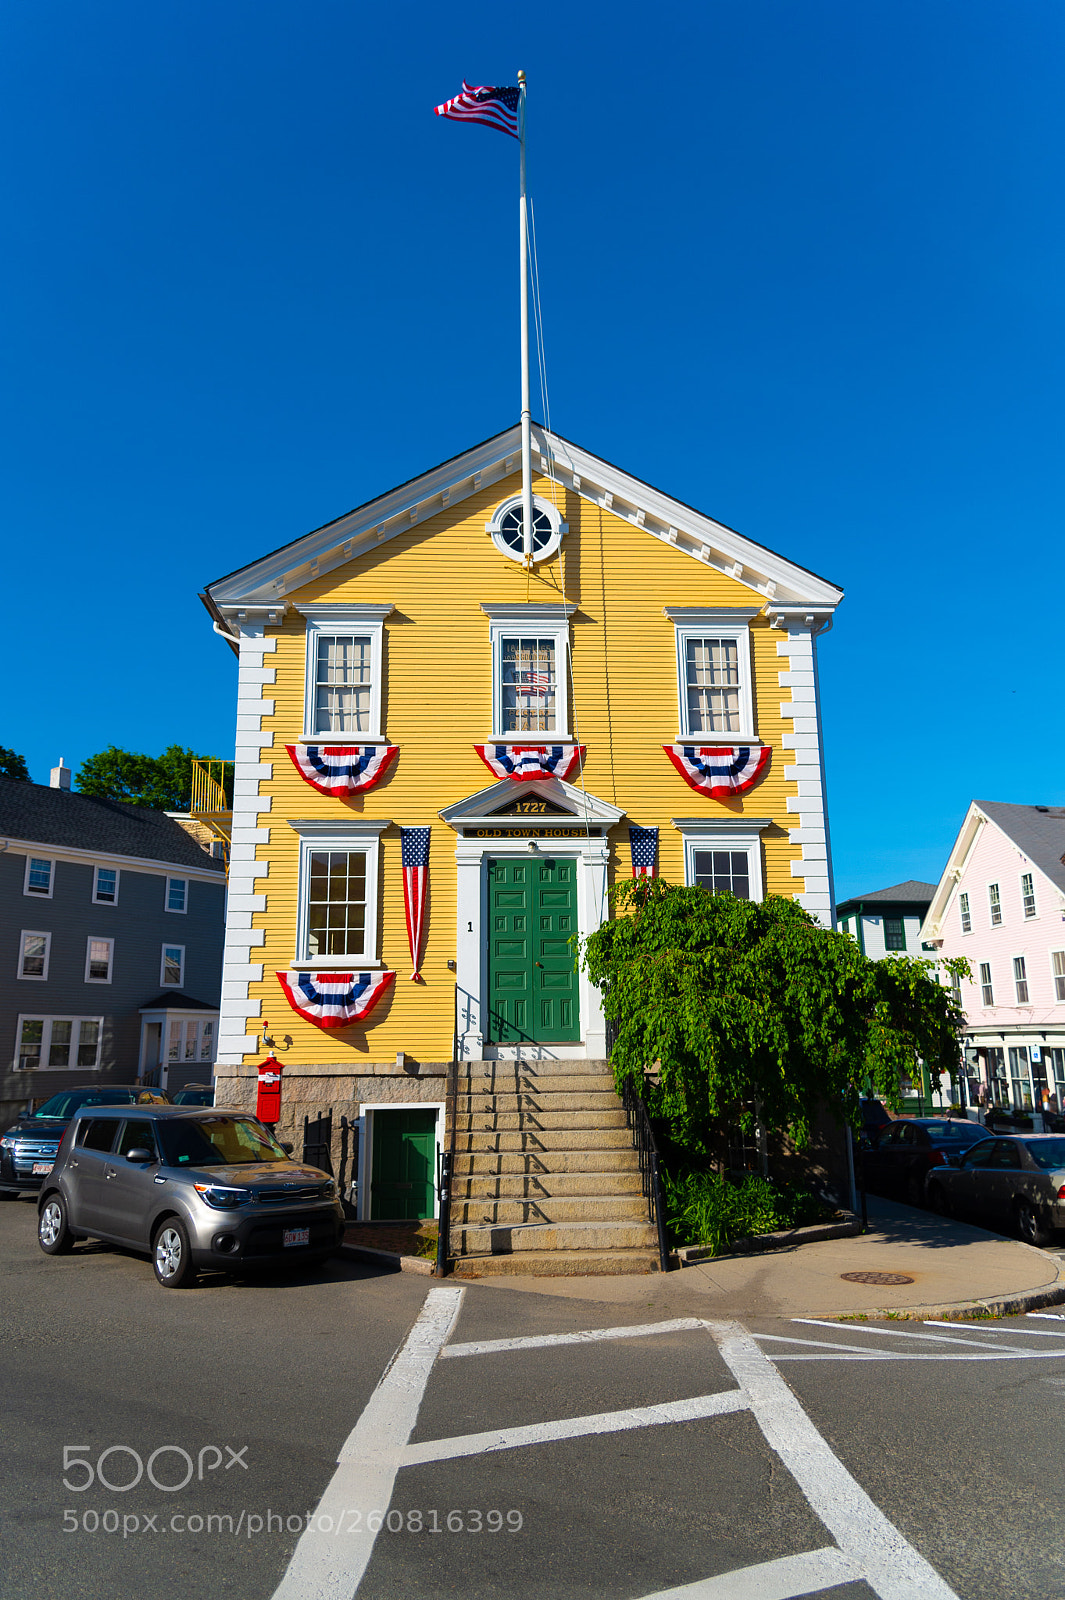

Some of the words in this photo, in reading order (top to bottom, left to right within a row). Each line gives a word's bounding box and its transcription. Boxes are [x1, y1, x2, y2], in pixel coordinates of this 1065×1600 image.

[515, 802, 547, 813] 1727
[476, 829, 502, 838] OLD
[506, 829, 540, 837] TOWN
[545, 829, 588, 837] HOUSE
[467, 921, 474, 933] 1
